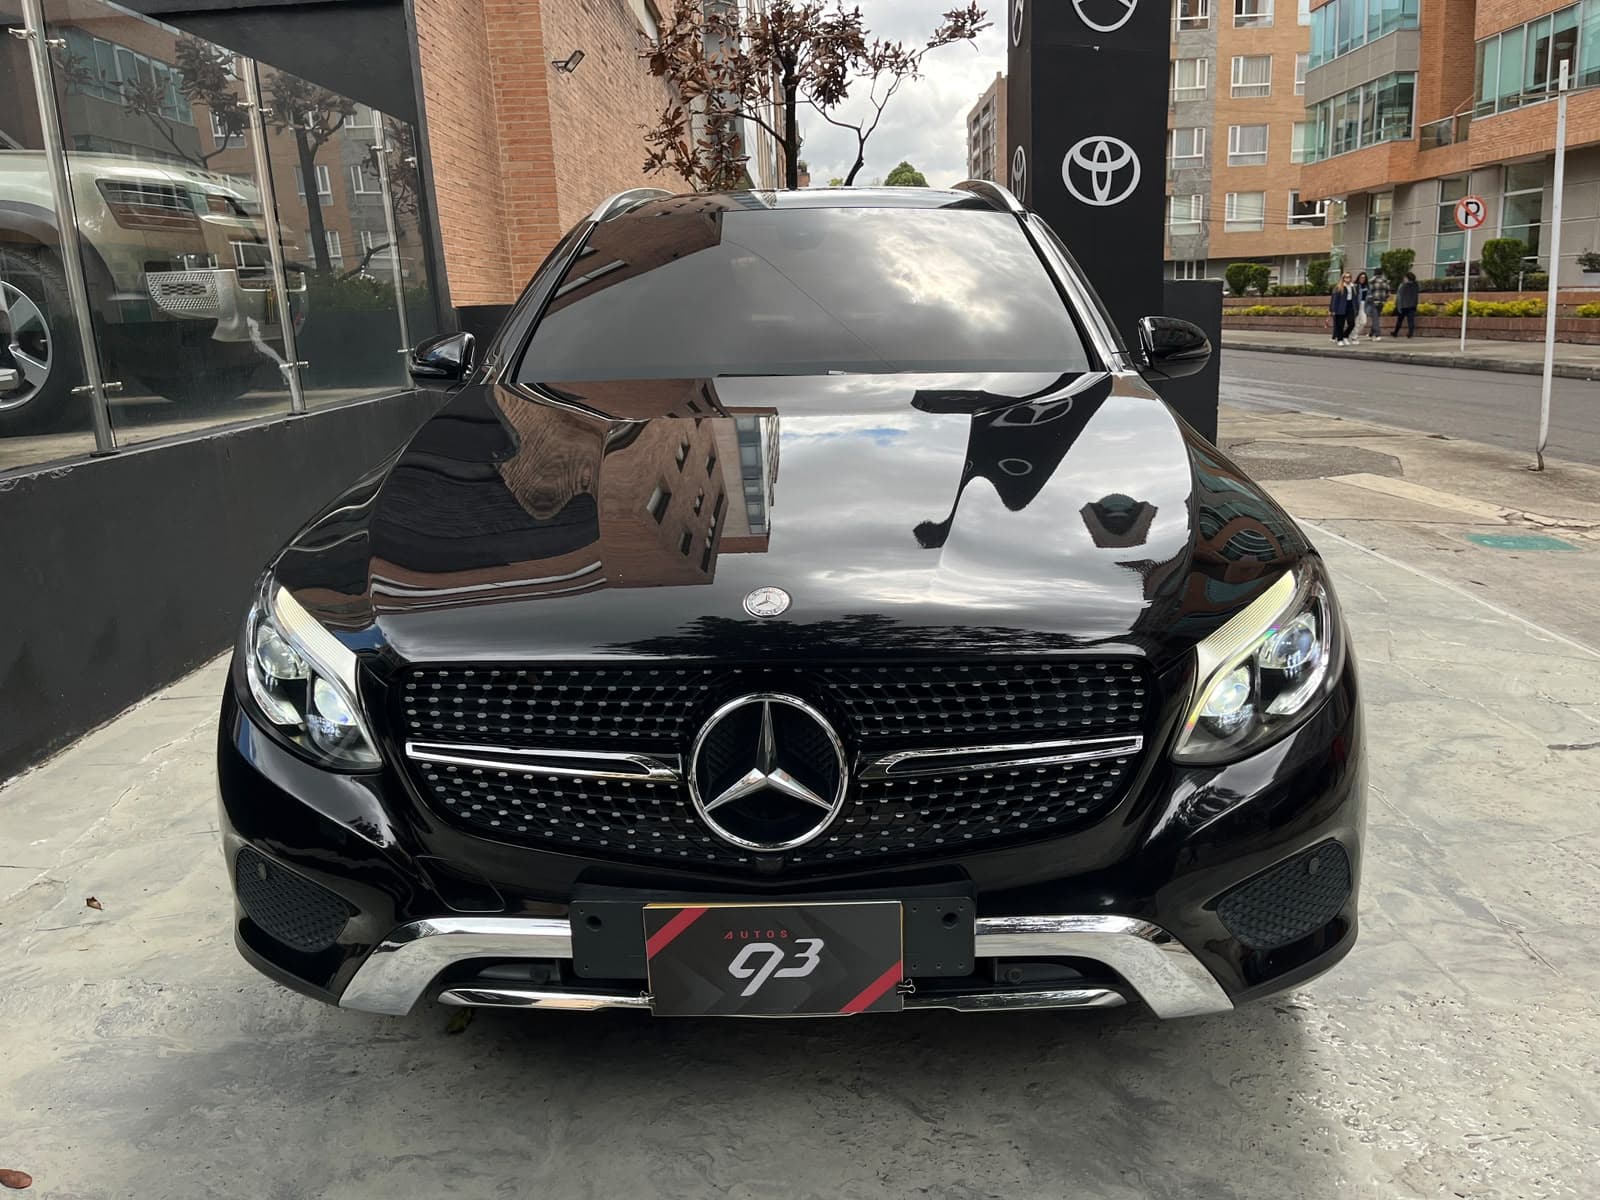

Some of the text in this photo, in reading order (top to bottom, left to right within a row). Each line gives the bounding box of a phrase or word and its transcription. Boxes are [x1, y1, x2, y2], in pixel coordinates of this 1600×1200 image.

[1465, 201, 1480, 225] P
[724, 929, 789, 940] AUTOS
[728, 938, 824, 997] 93
